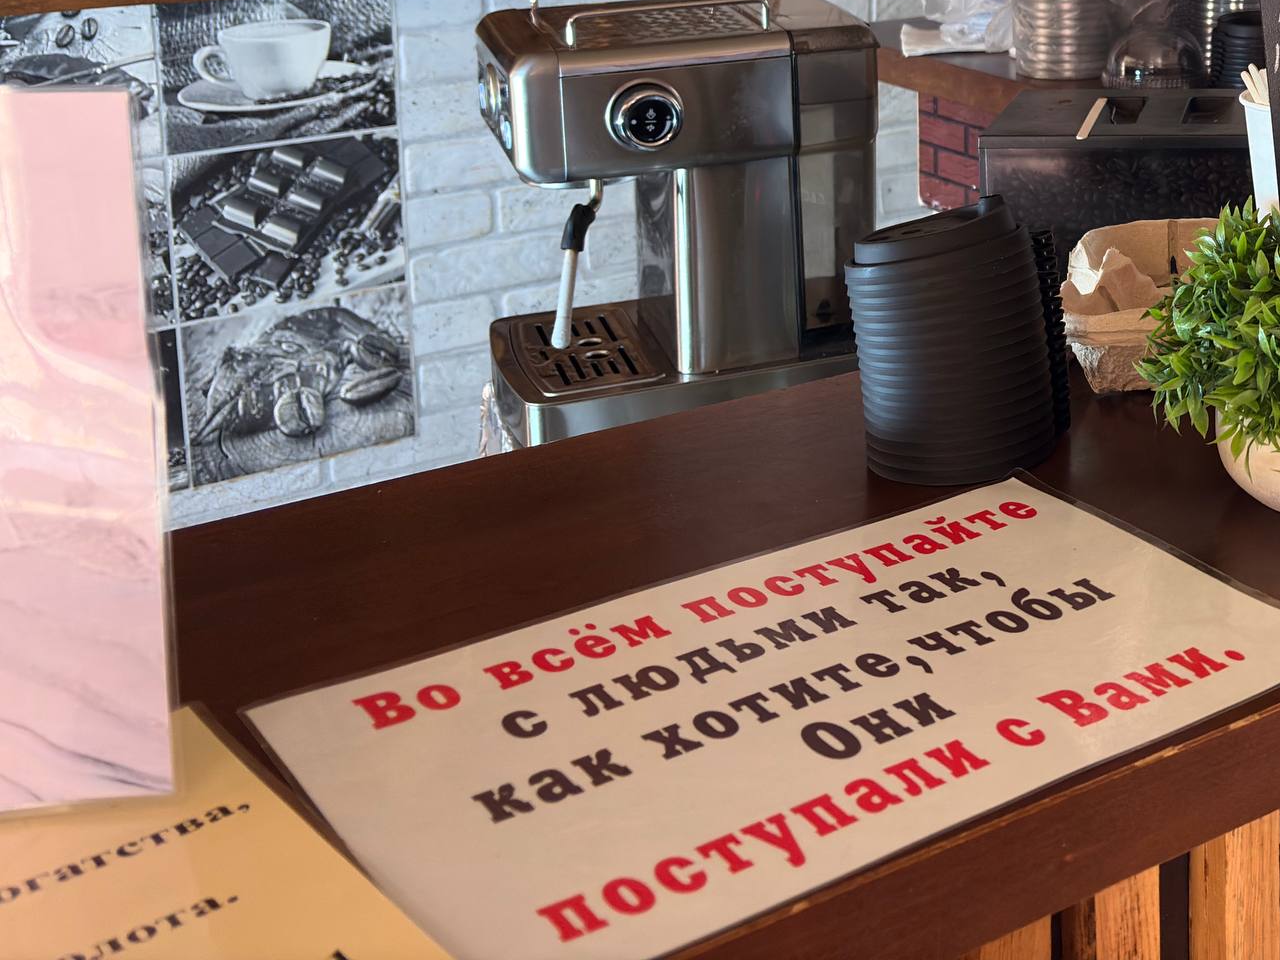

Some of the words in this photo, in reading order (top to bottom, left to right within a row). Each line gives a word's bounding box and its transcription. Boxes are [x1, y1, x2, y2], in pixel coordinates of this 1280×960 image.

[351, 684, 461, 730] Во
[483, 615, 673, 690] всём
[680, 500, 1039, 623] поступайте
[501, 710, 548, 739] с
[568, 606, 858, 718] людьми
[860, 566, 1008, 614] так,
[471, 748, 633, 824] как
[536, 738, 991, 943] поступали
[995, 716, 1046, 748] с
[1036, 645, 1247, 728] Вами.
[800, 691, 957, 760] Они
[0, 803, 251, 904] огатства,
